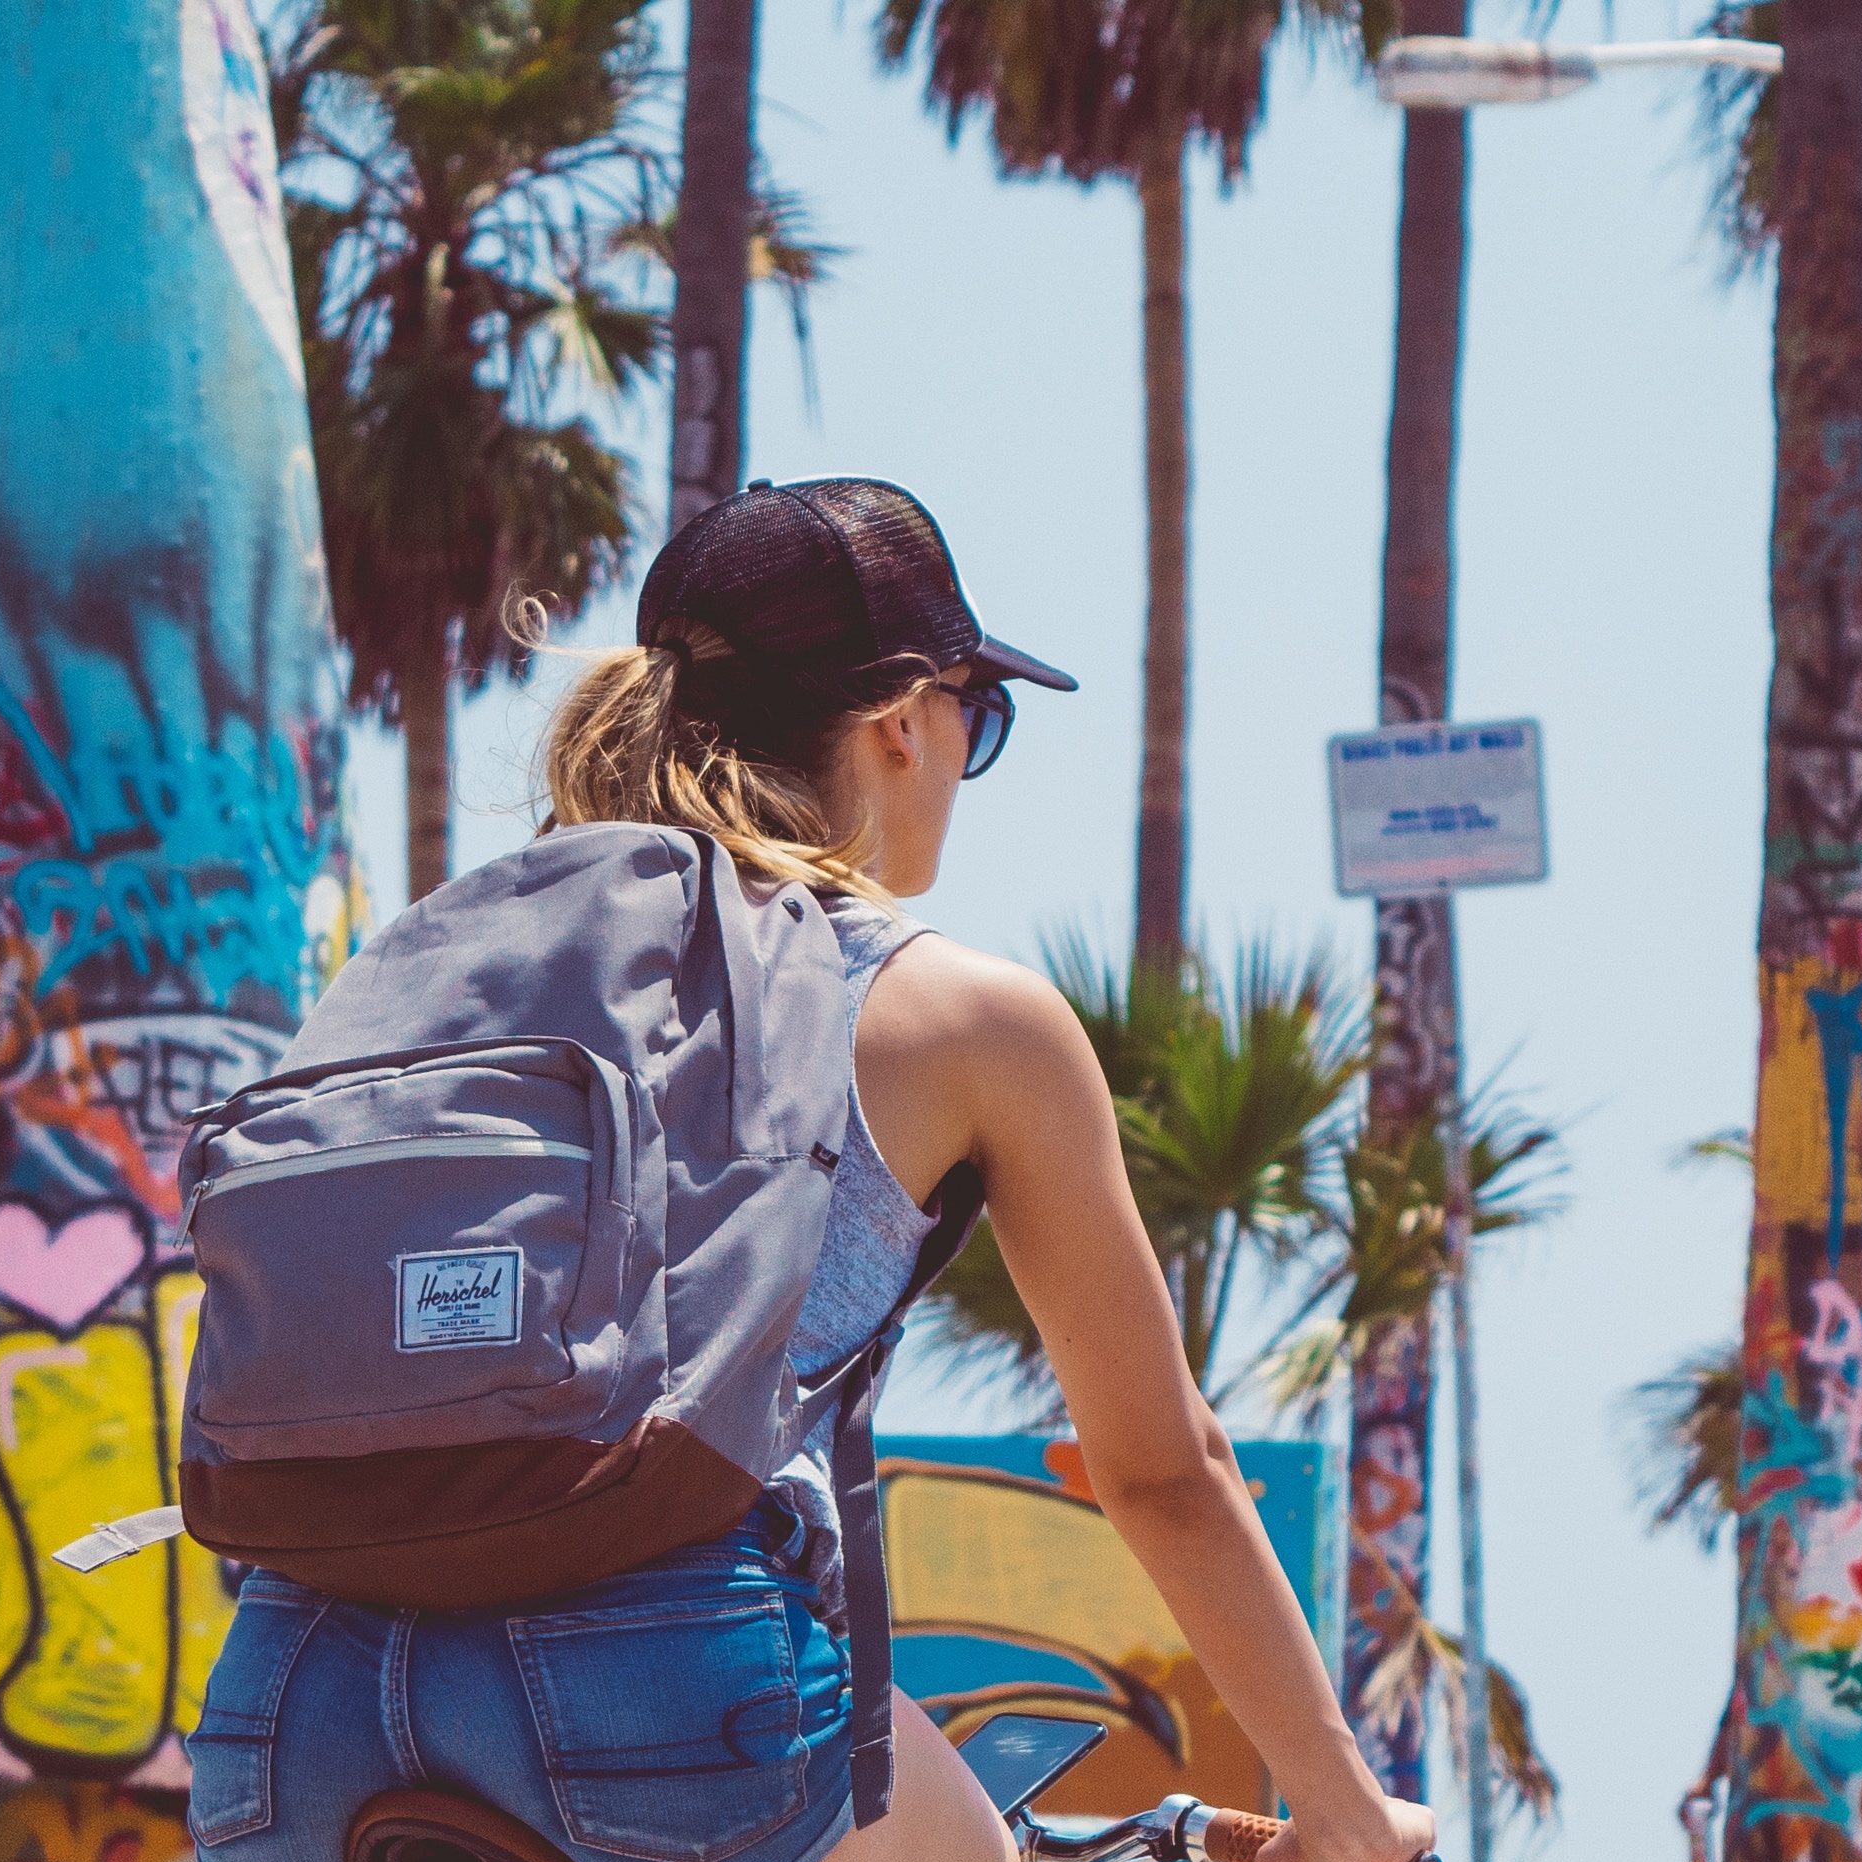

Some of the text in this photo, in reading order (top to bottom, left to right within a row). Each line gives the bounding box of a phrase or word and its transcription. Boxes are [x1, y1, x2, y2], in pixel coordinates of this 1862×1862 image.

[416, 1267, 503, 1314] Herschel
[437, 1318, 480, 1328] TRADE MARK
